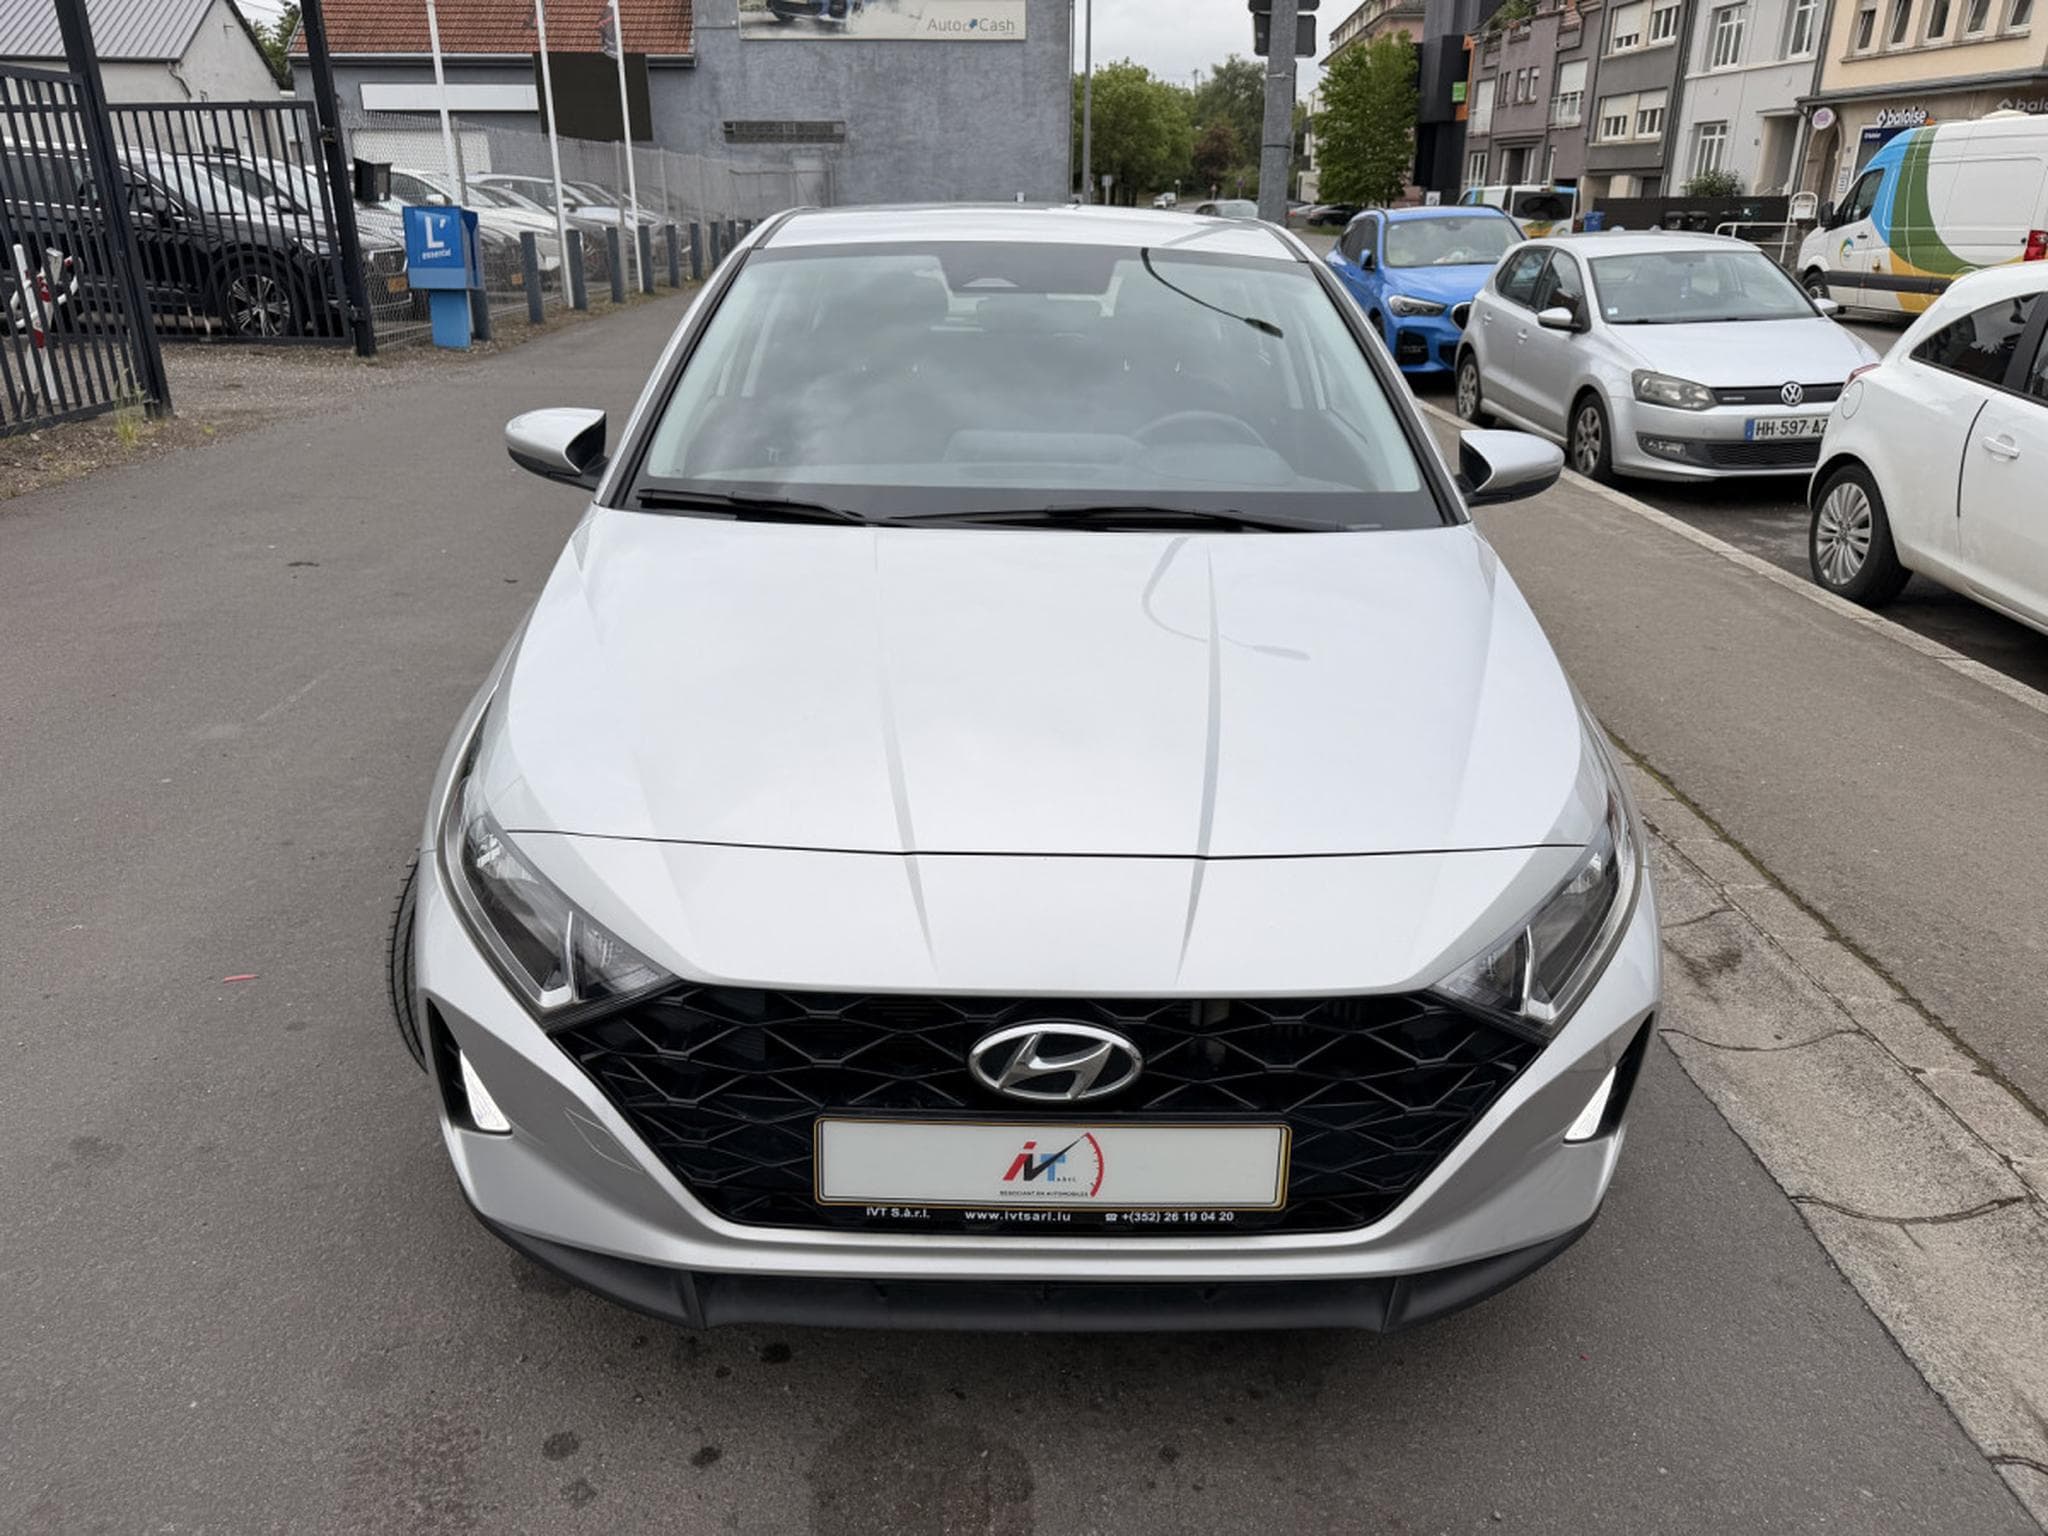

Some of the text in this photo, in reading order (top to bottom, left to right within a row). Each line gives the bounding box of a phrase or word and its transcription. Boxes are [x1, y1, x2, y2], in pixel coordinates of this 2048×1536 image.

[927, 18, 1015, 31] Auto Cash
[866, 1207, 887, 1217] IVT
[1121, 1211, 1161, 1223] +(352)
[1184, 1211, 1198, 1221] 19
[1200, 1211, 1216, 1221] 04
[1219, 1211, 1234, 1221] 20
